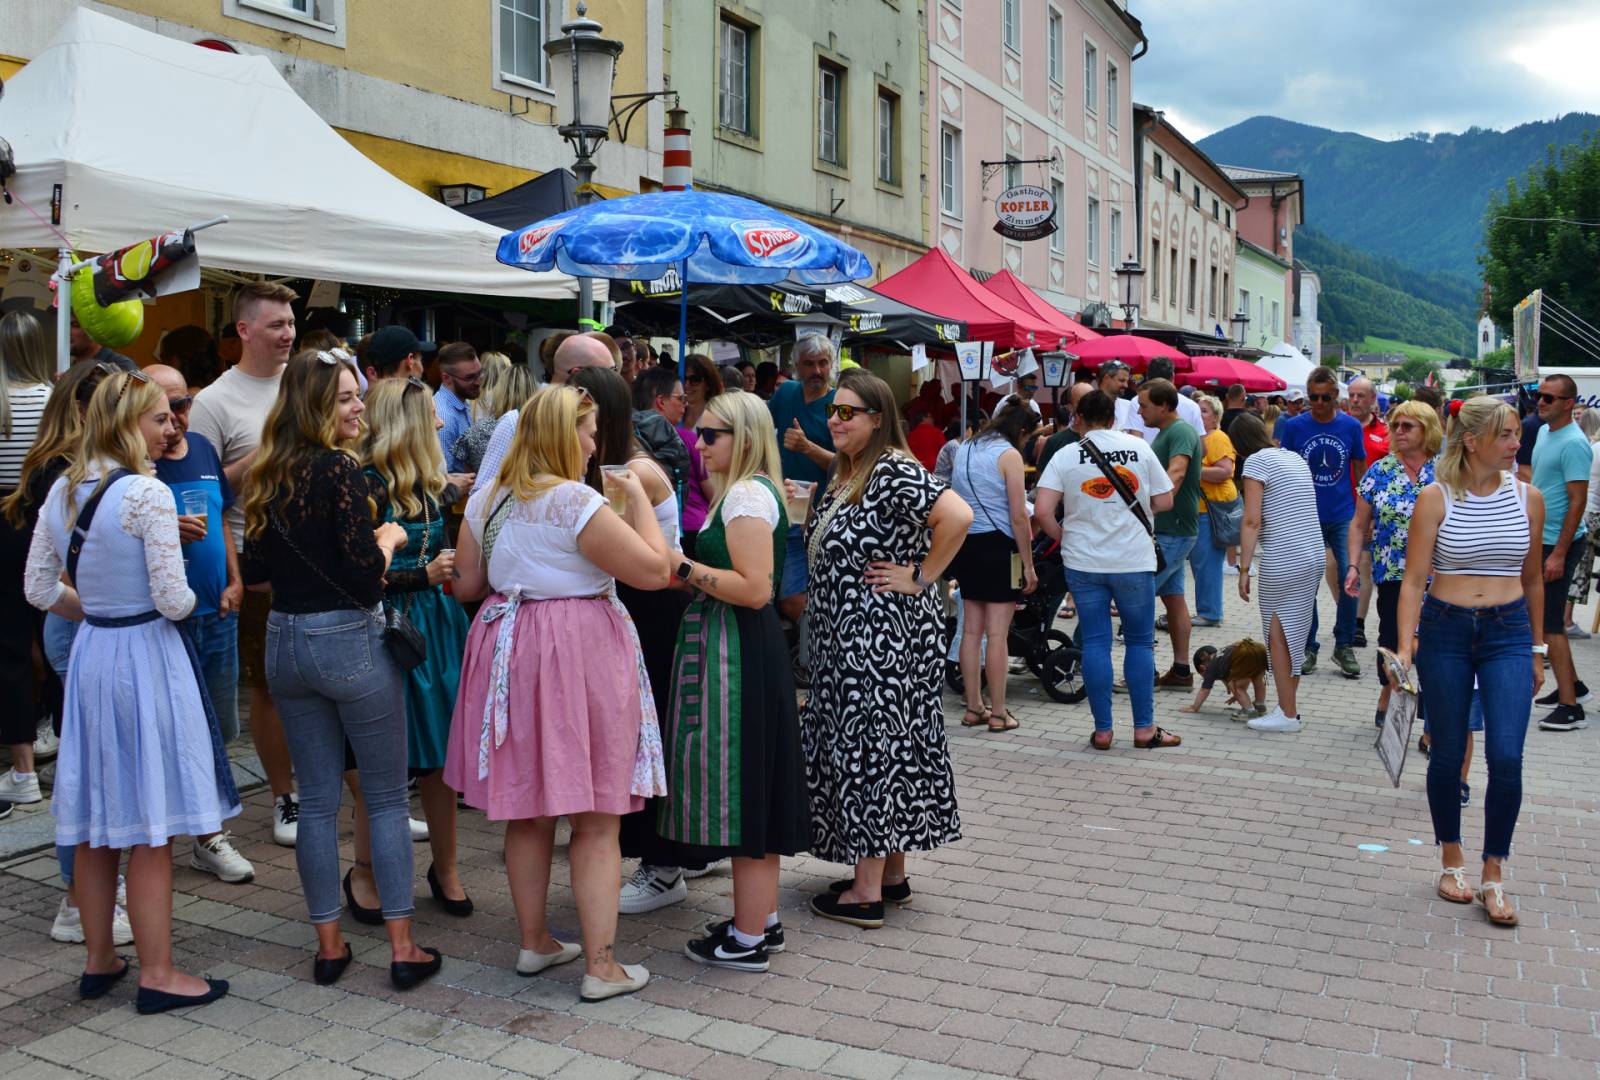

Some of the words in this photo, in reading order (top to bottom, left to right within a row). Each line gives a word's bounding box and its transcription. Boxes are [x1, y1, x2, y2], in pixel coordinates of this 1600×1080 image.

[1006, 188, 1045, 199] Gasthof
[1000, 200, 1050, 213] KOFLER
[1005, 214, 1044, 225] Zimmer
